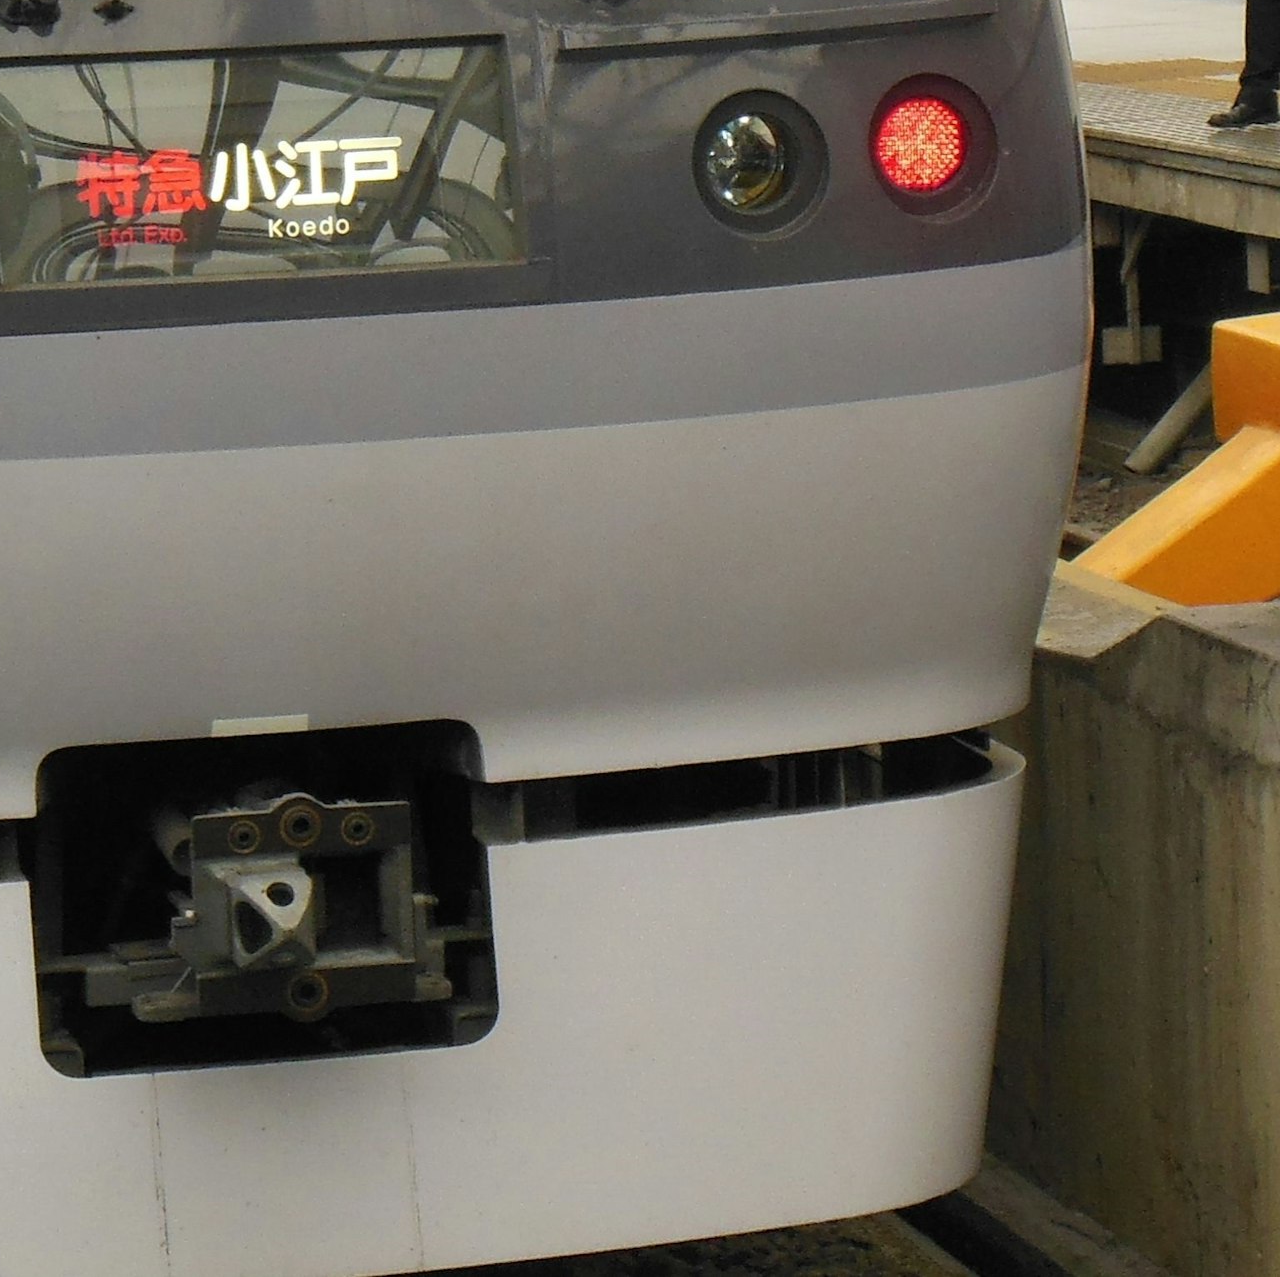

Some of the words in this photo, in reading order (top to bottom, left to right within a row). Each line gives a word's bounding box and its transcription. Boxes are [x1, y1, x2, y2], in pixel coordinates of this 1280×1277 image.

[76, 148, 208, 219] 特急
[211, 136, 402, 212] 小江戸
[268, 215, 350, 238] Koedo
